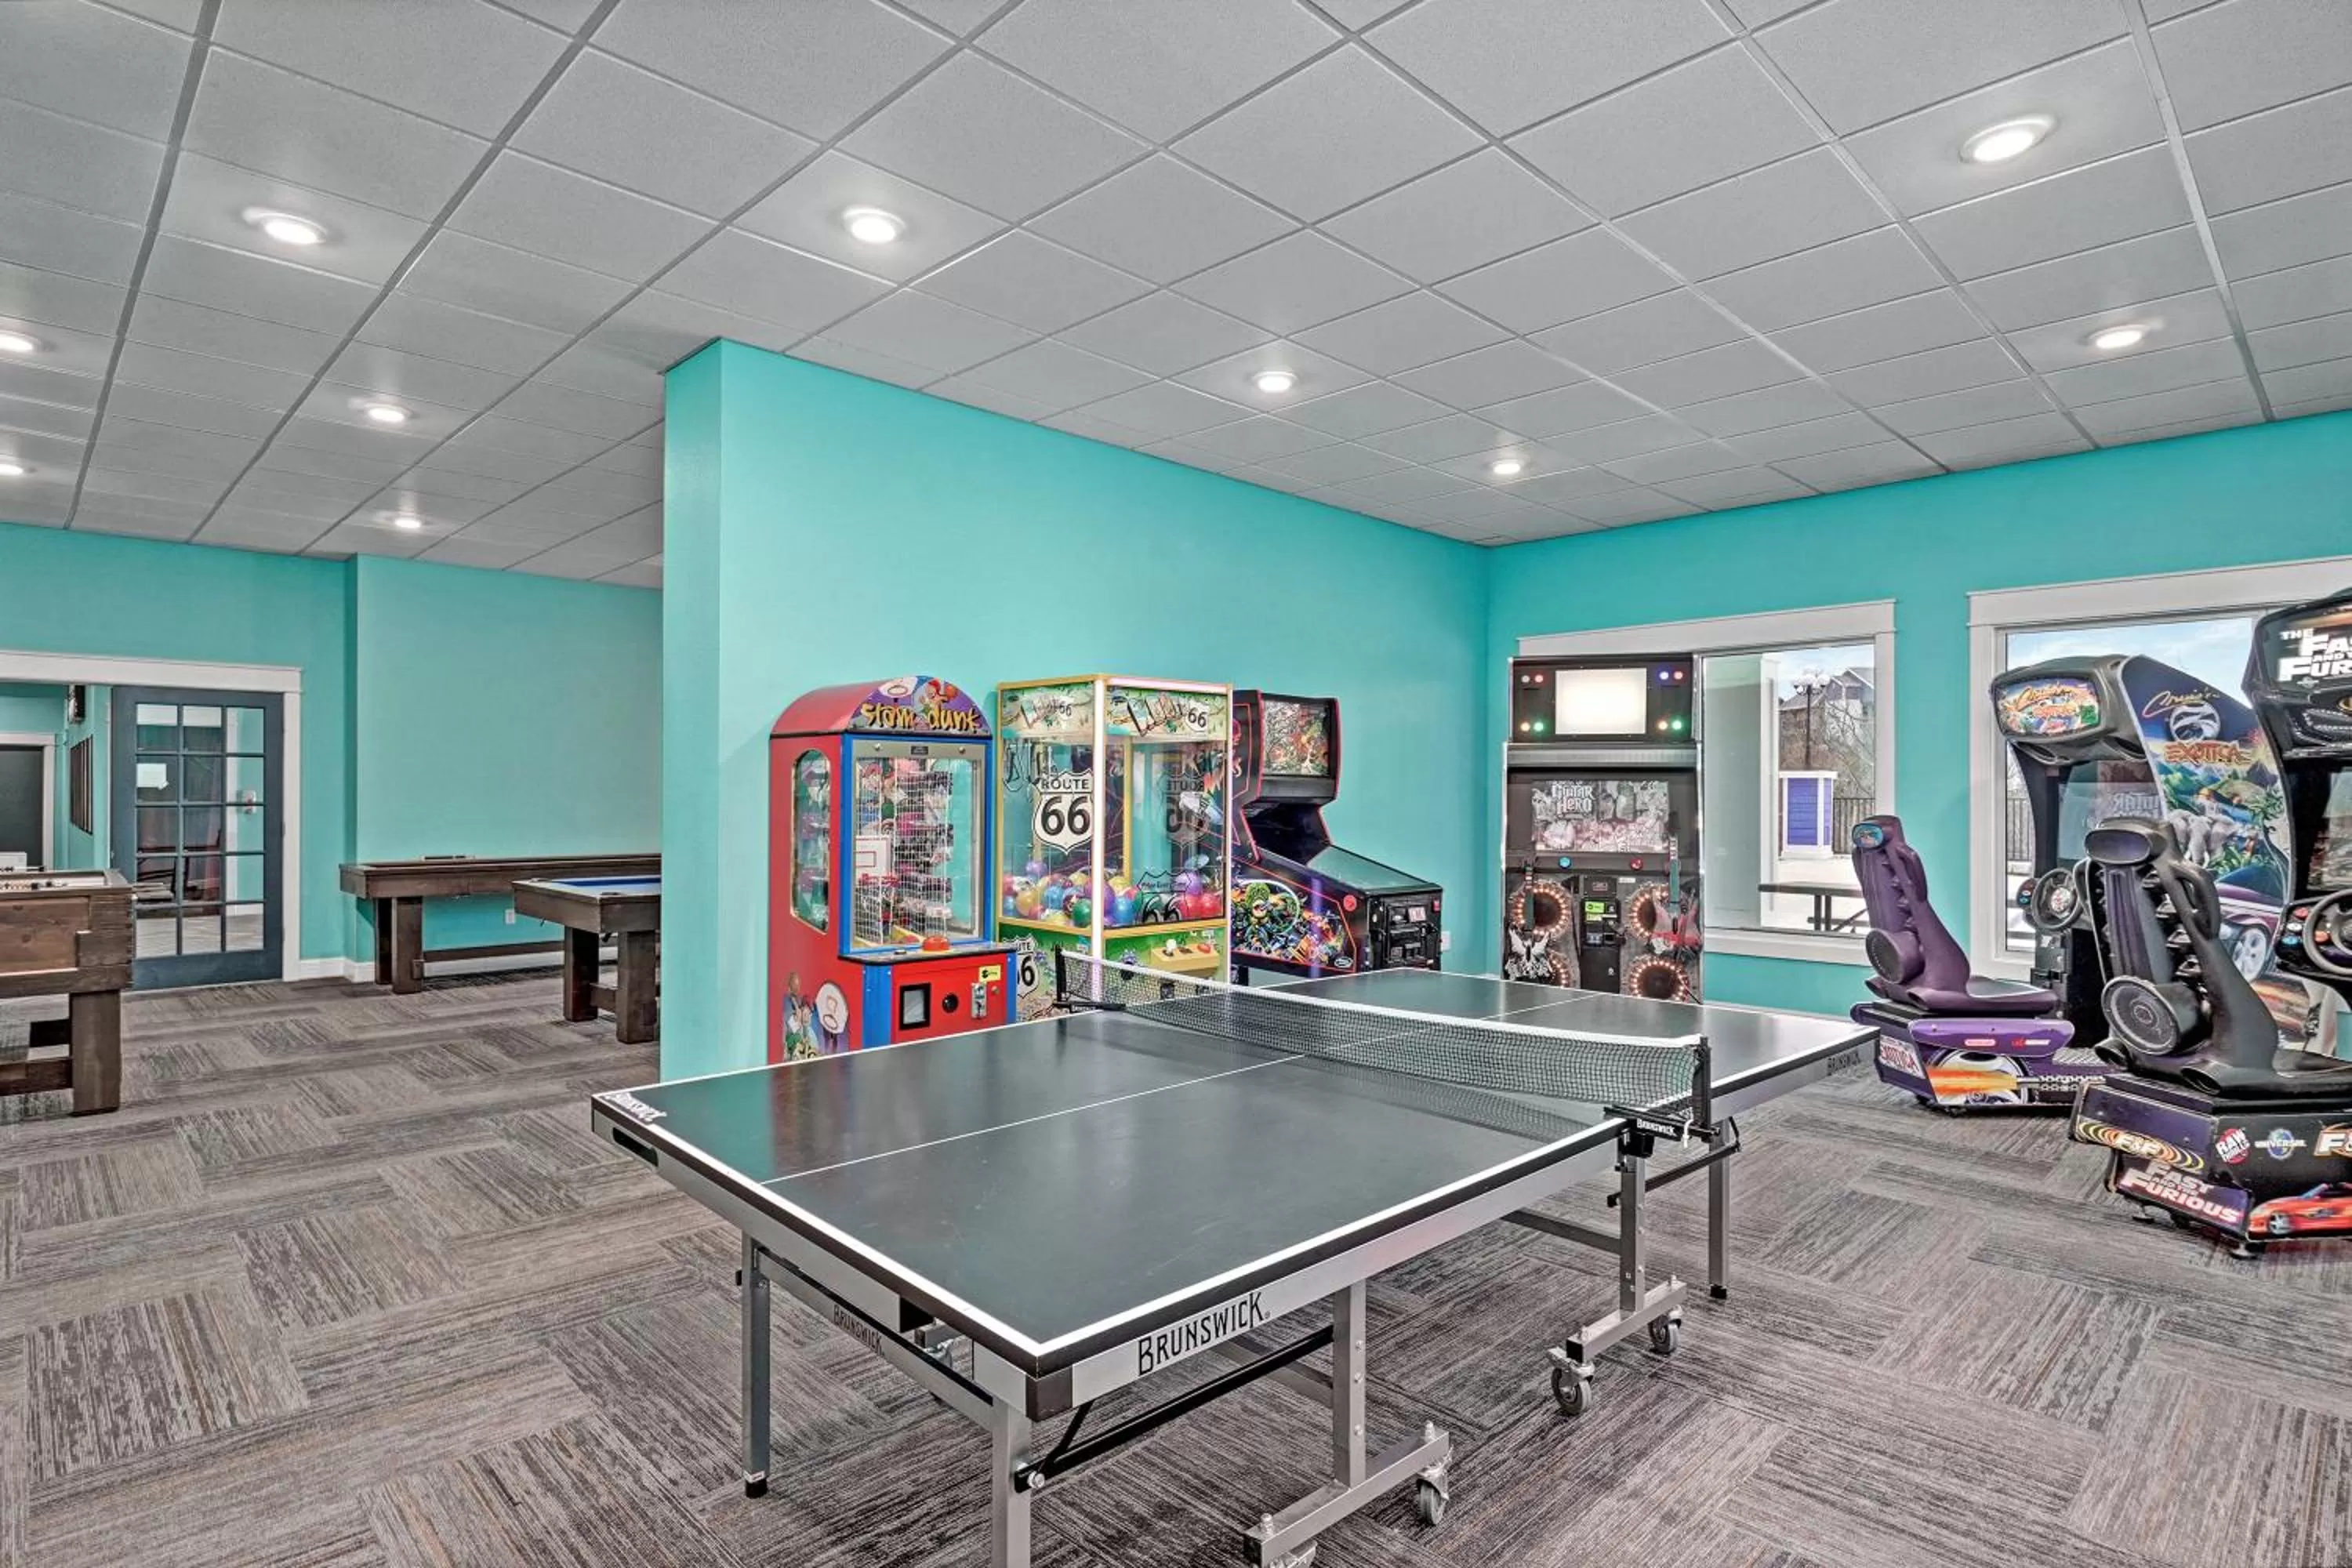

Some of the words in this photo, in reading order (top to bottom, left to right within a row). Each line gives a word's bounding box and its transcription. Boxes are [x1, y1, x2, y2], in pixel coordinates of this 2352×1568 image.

[2278, 628, 2314, 641] THE
[2299, 633, 2352, 656] FA
[1058, 700, 1072, 717] 66
[1187, 707, 1207, 728] 66
[1041, 778, 1089, 790] ROUTE
[1040, 796, 1091, 836] 66
[2146, 1159, 2215, 1193] FAST
[2119, 1167, 2241, 1224] FURIOUS
[833, 1303, 883, 1356] BRUNSWICK
[1138, 1291, 1264, 1376] BRUNSWICK
